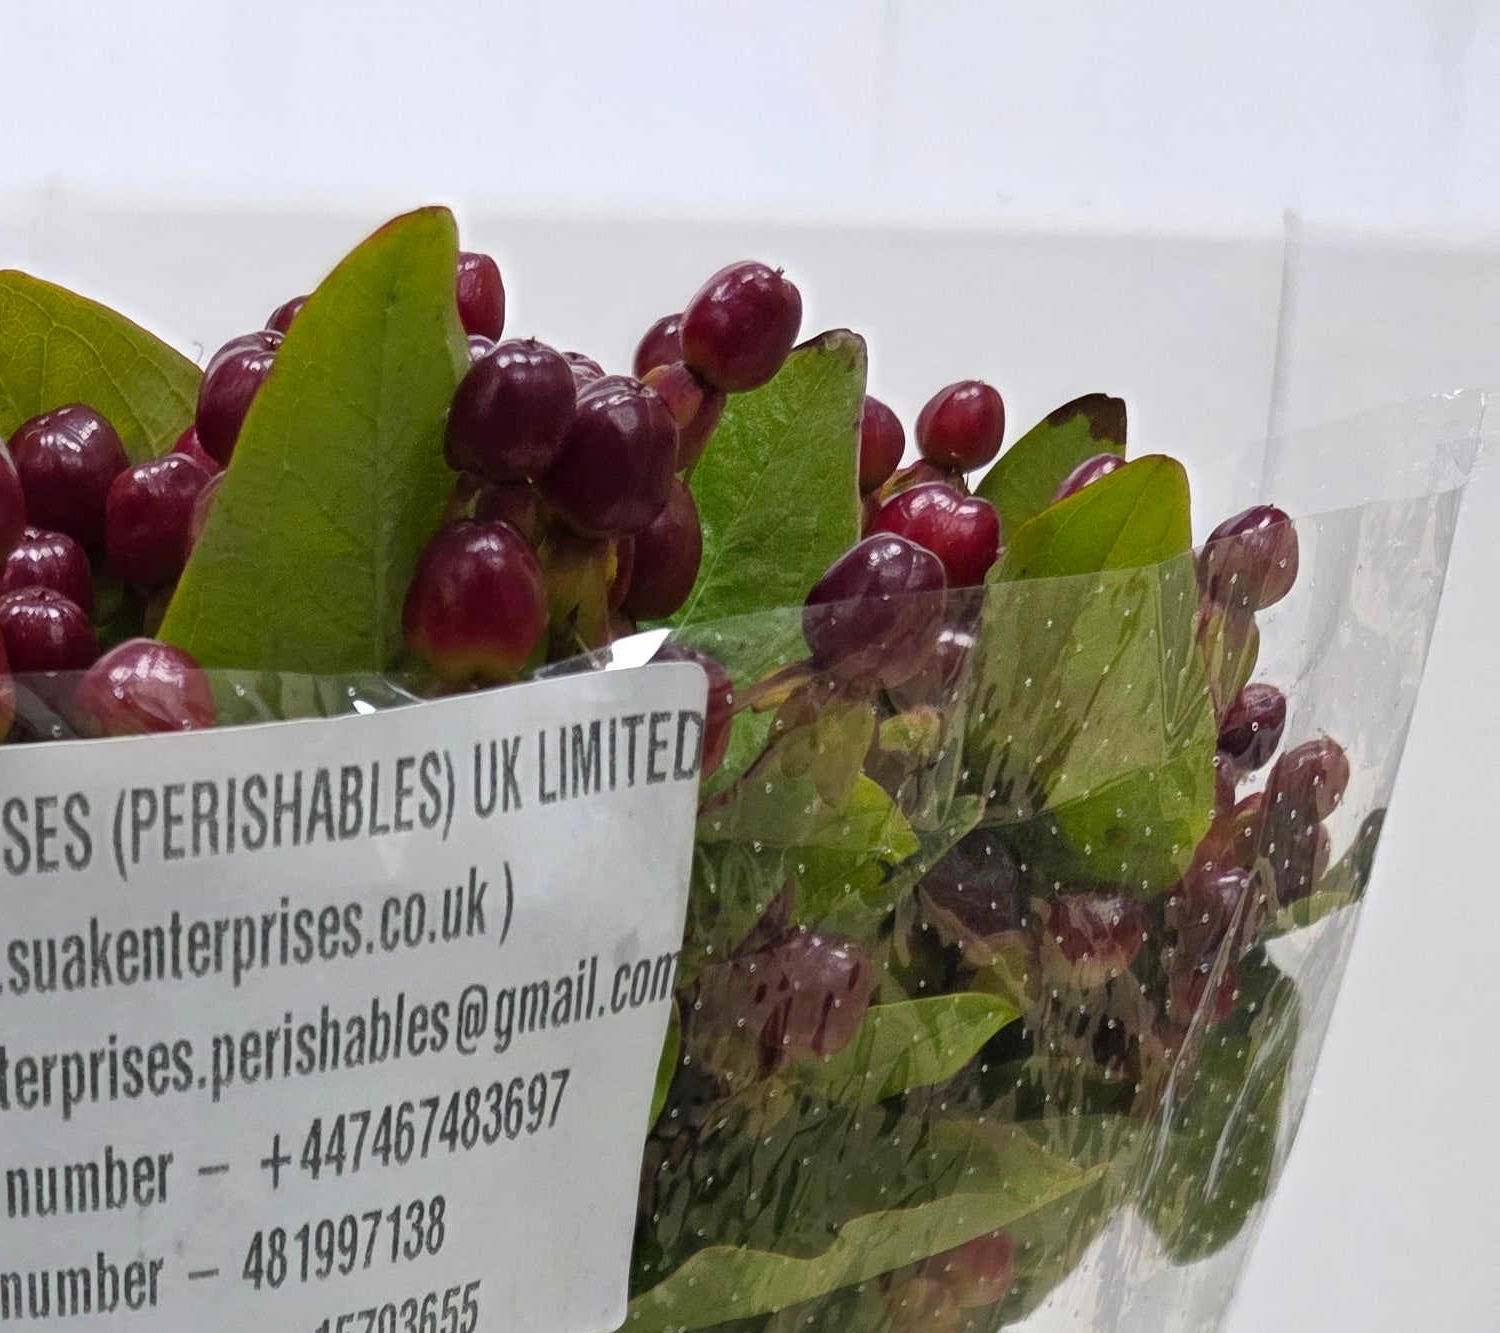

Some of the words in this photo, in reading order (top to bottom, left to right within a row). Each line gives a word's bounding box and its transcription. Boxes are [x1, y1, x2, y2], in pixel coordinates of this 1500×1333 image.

[112, 750, 455, 880] (PERISHABLES)
[474, 736, 522, 820] UK
[539, 710, 703, 804] LIMITED
[6, 1145, 173, 1218] number
[261, 1068, 570, 1189] +447467483697
[0, 1251, 164, 1319] number
[242, 1195, 446, 1290] 481997138
